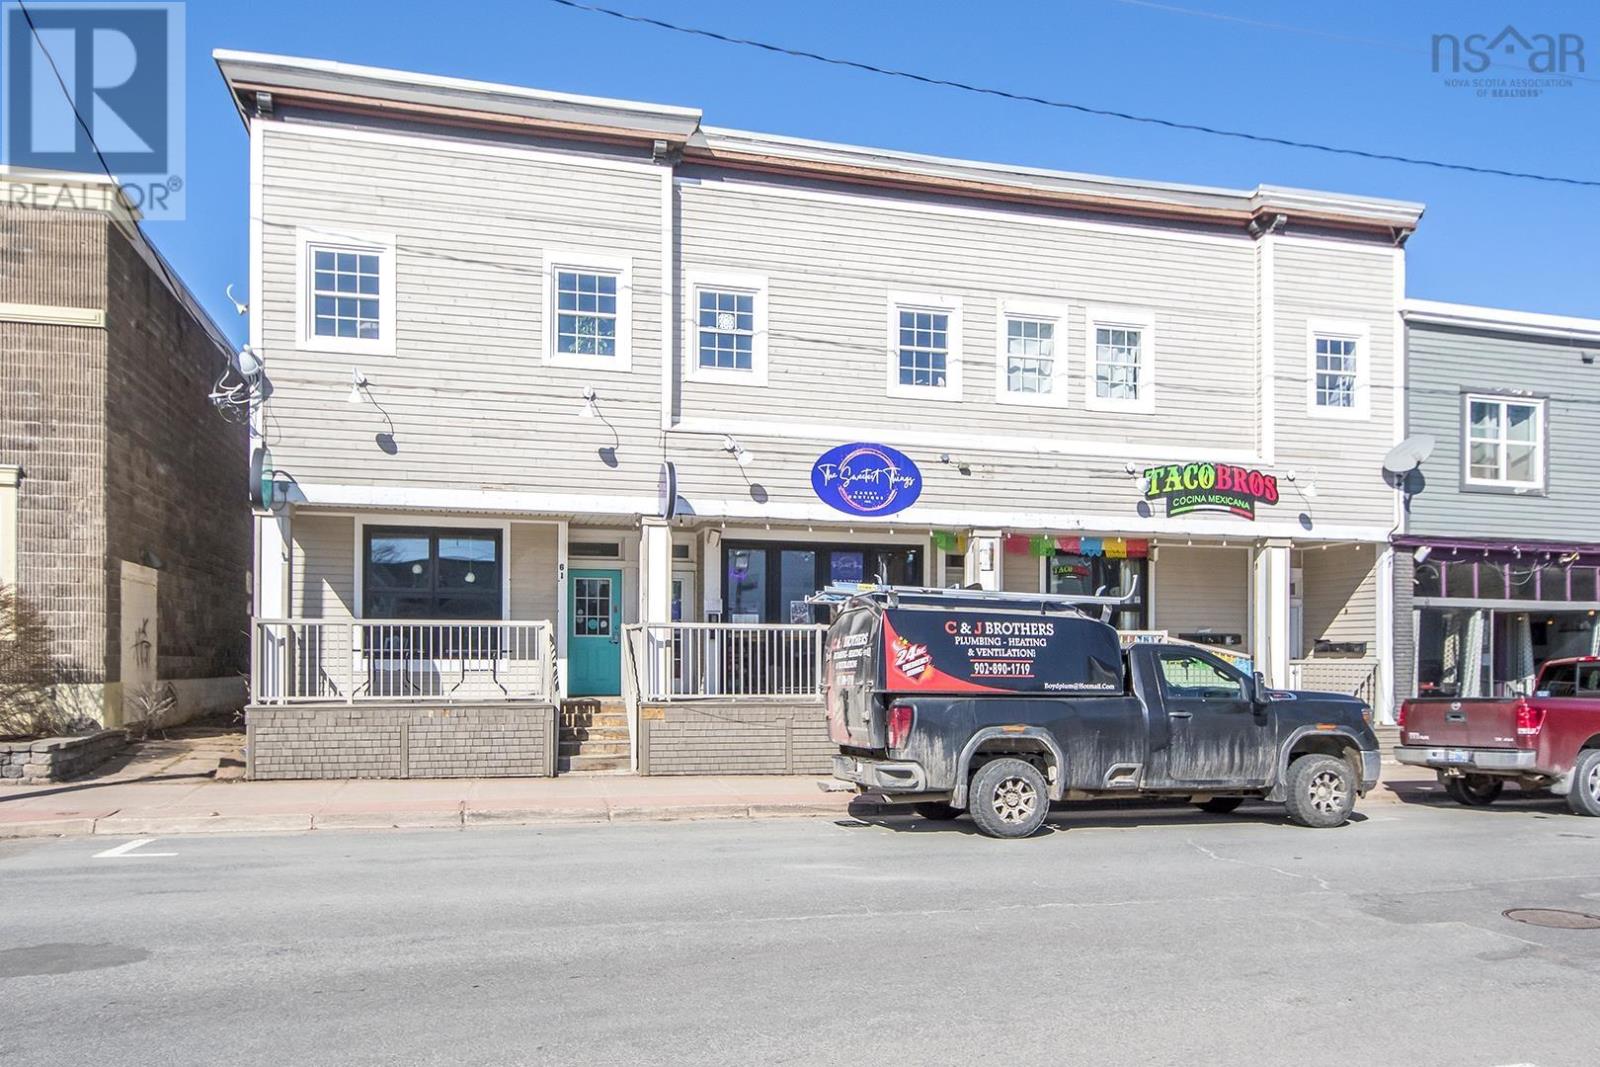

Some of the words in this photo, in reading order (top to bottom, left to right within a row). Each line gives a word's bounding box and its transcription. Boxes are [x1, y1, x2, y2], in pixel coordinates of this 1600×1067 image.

[818, 463, 838, 486] The
[883, 467, 915, 490] Things
[1145, 462, 1215, 496] TACO
[1215, 463, 1278, 501] BROS
[1173, 495, 1207, 507] COCINA
[1208, 495, 1250, 509] MEXICANA
[945, 621, 957, 635] C
[960, 622, 972, 635] &
[974, 622, 982, 635] J
[985, 622, 1055, 636] BROTHERS
[955, 637, 1001, 646] PLUMBING
[1008, 638, 1047, 647] HEATING
[968, 648, 975, 657] &
[974, 663, 1030, 675] 902-890-1719
